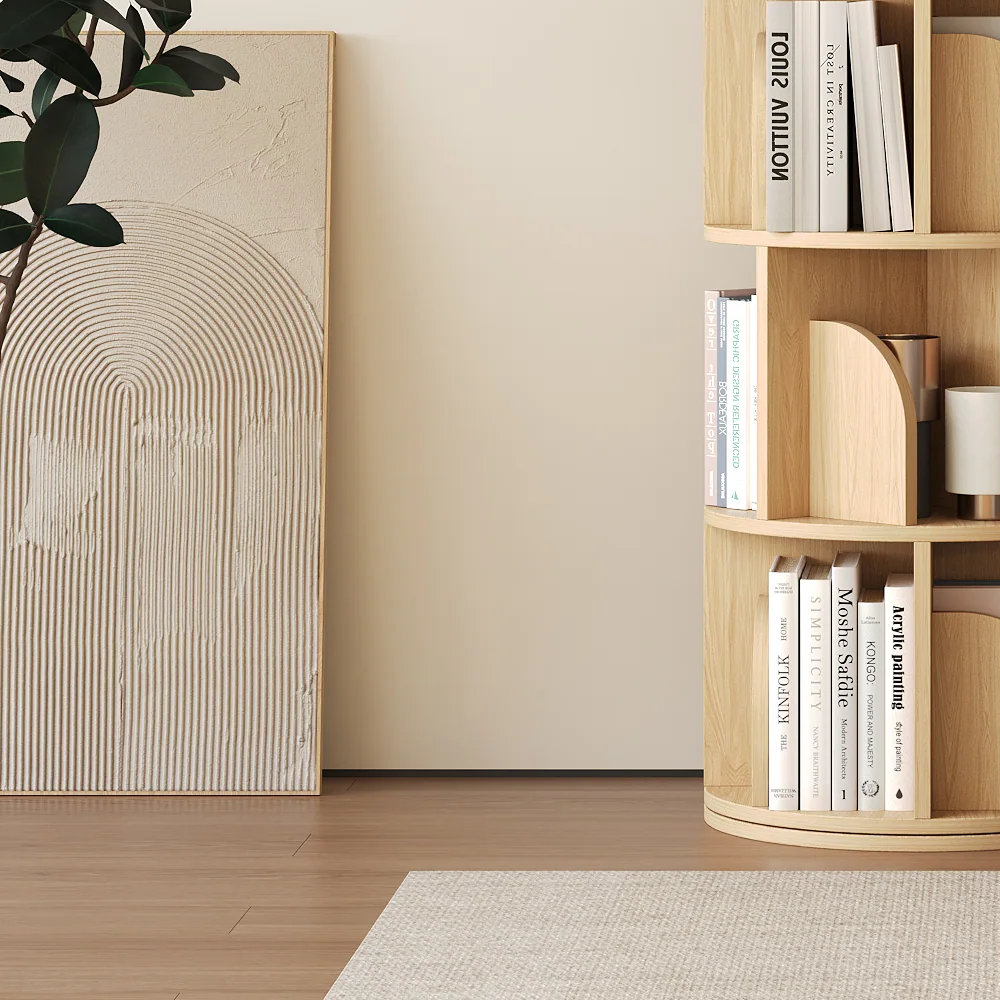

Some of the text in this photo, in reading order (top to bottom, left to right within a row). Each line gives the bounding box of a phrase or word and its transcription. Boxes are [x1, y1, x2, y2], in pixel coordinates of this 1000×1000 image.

[778, 655, 789, 724] KINFOLK
[810, 596, 821, 711] SIMPLICITY
[837, 588, 853, 708] Moshe Safdie
[866, 641, 876, 685] KONGO:
[891, 605, 904, 710] Acrylic painting
[894, 721, 903, 772] style of painting
